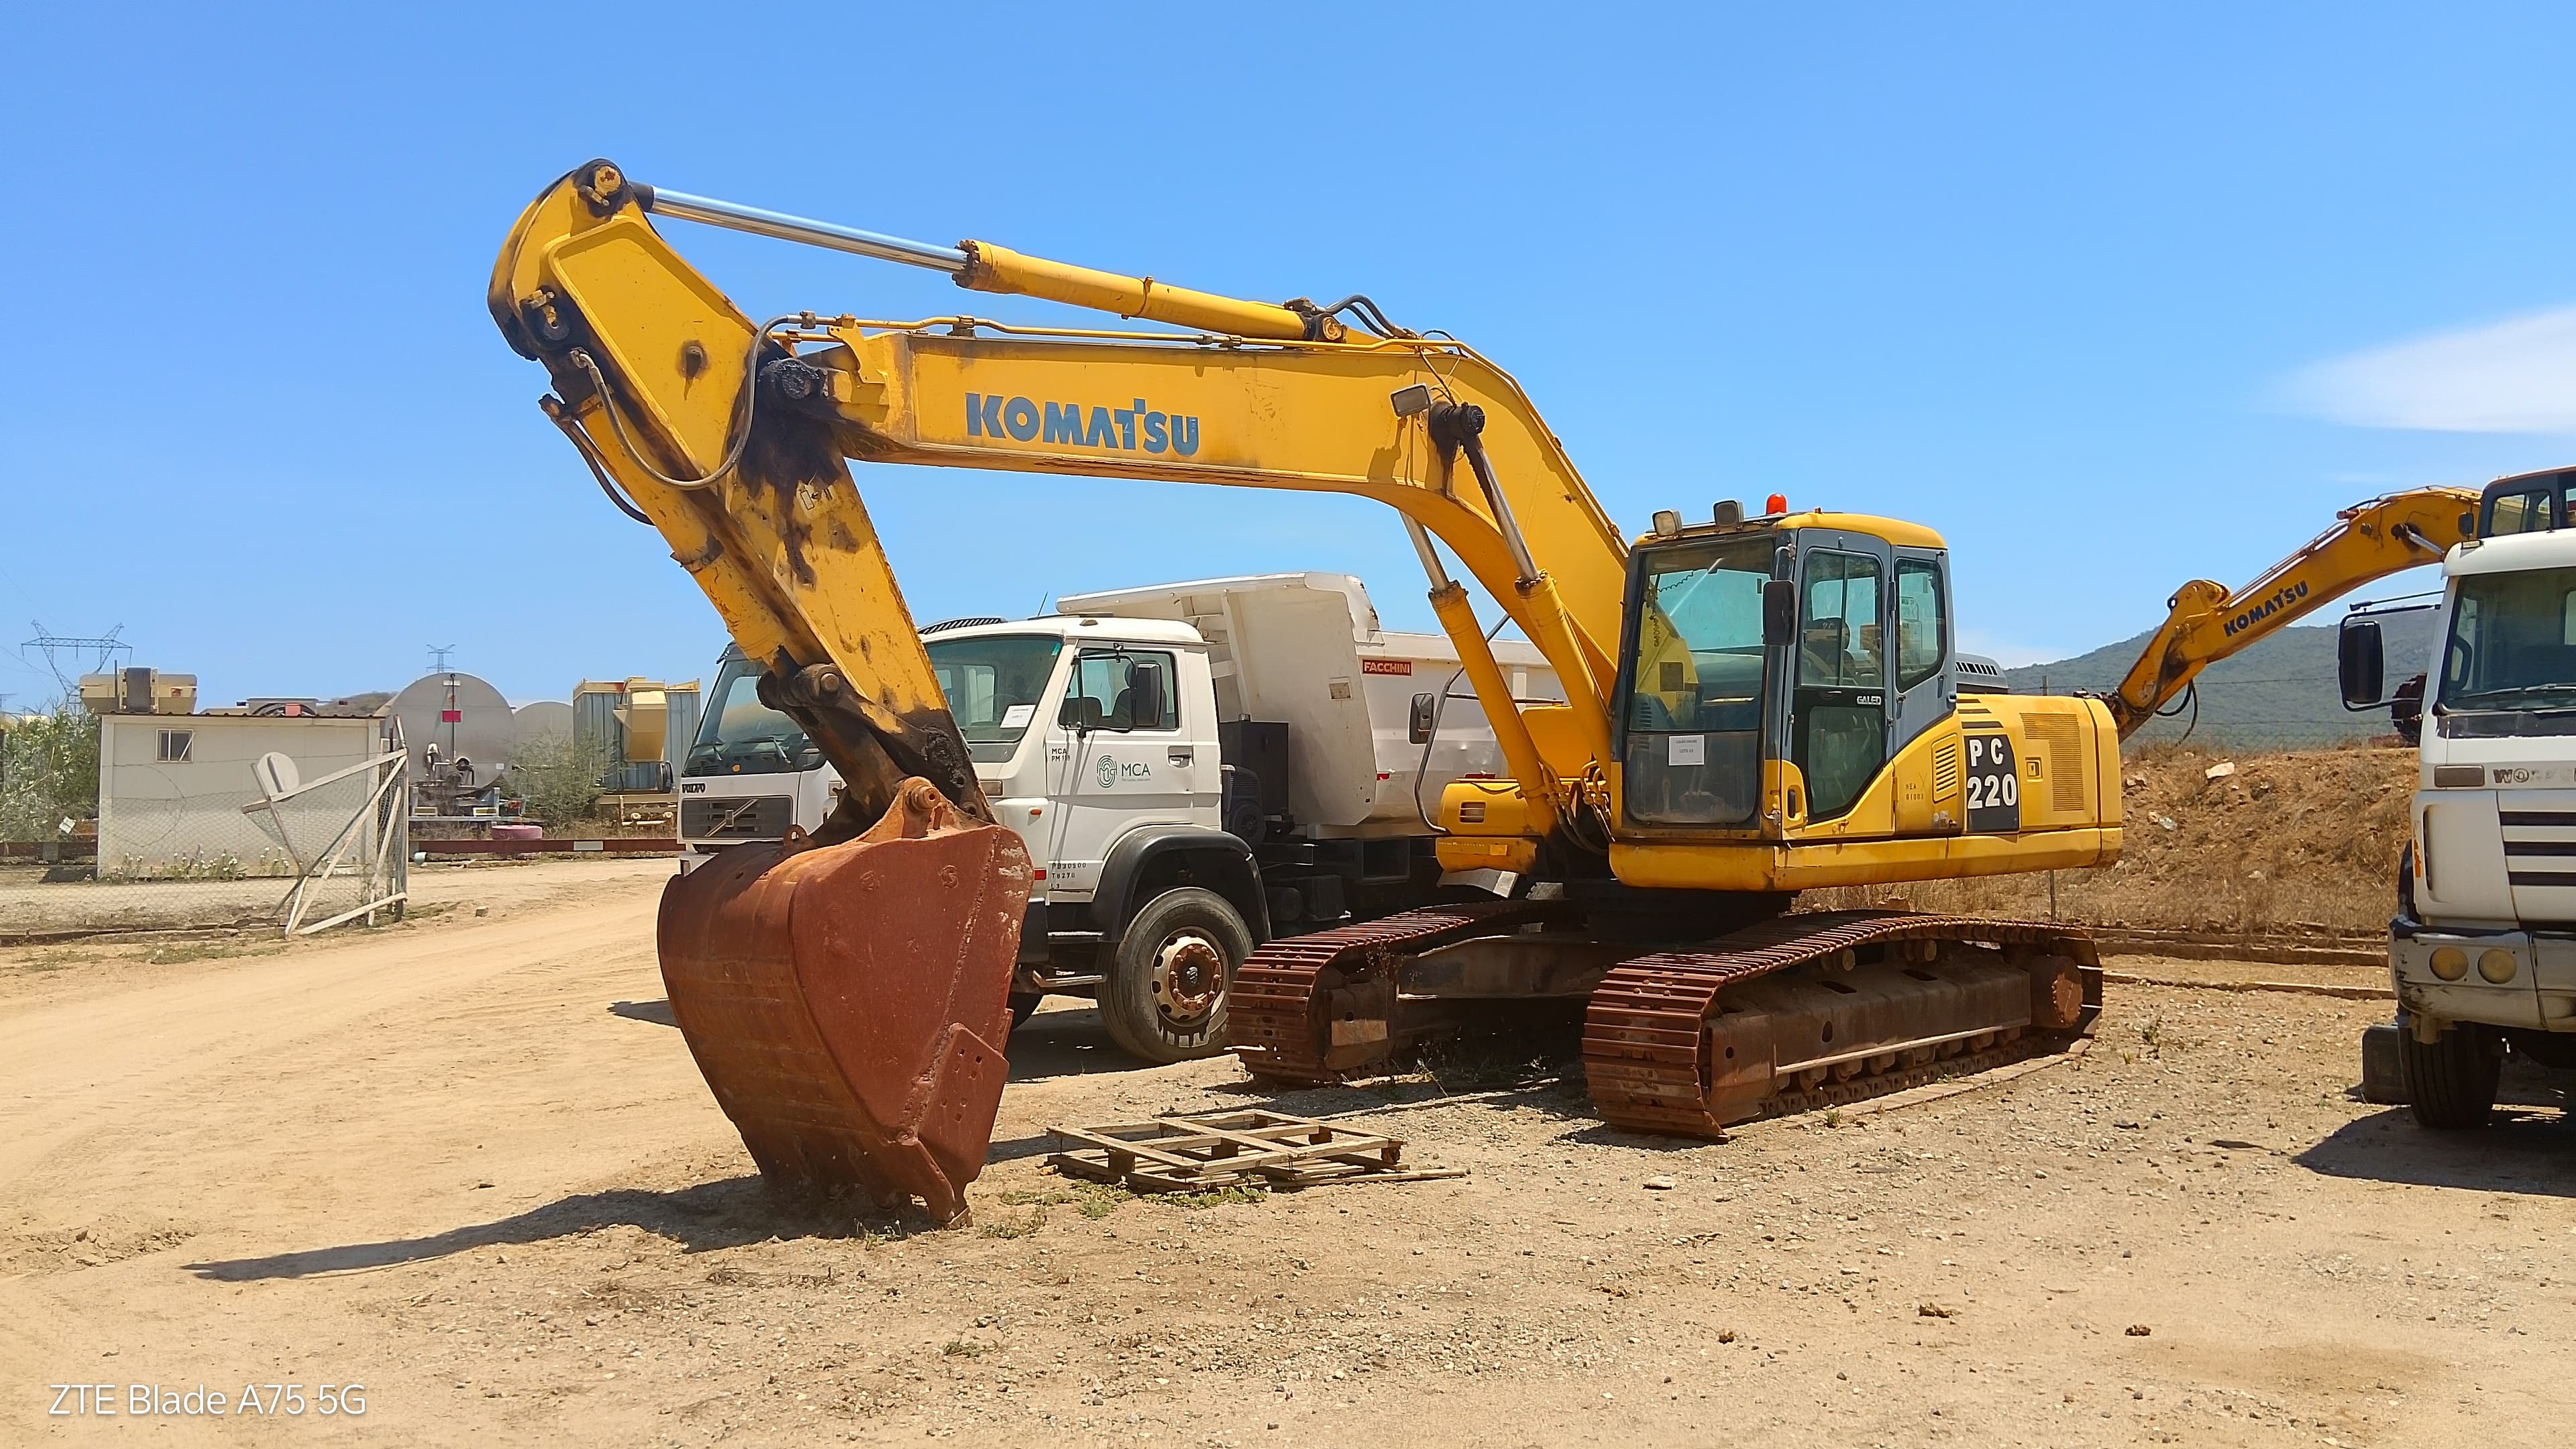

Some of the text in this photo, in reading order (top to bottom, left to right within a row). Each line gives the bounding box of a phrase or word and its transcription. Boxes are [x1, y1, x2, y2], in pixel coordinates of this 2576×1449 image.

[965, 392, 1199, 456] KOMATSU
[2222, 580, 2308, 637] KOMATSU
[1364, 661, 1410, 674] FACCHINI
[1121, 763, 1151, 777] MCA
[682, 783, 706, 793] VOLVO
[1966, 773, 2018, 809] 220
